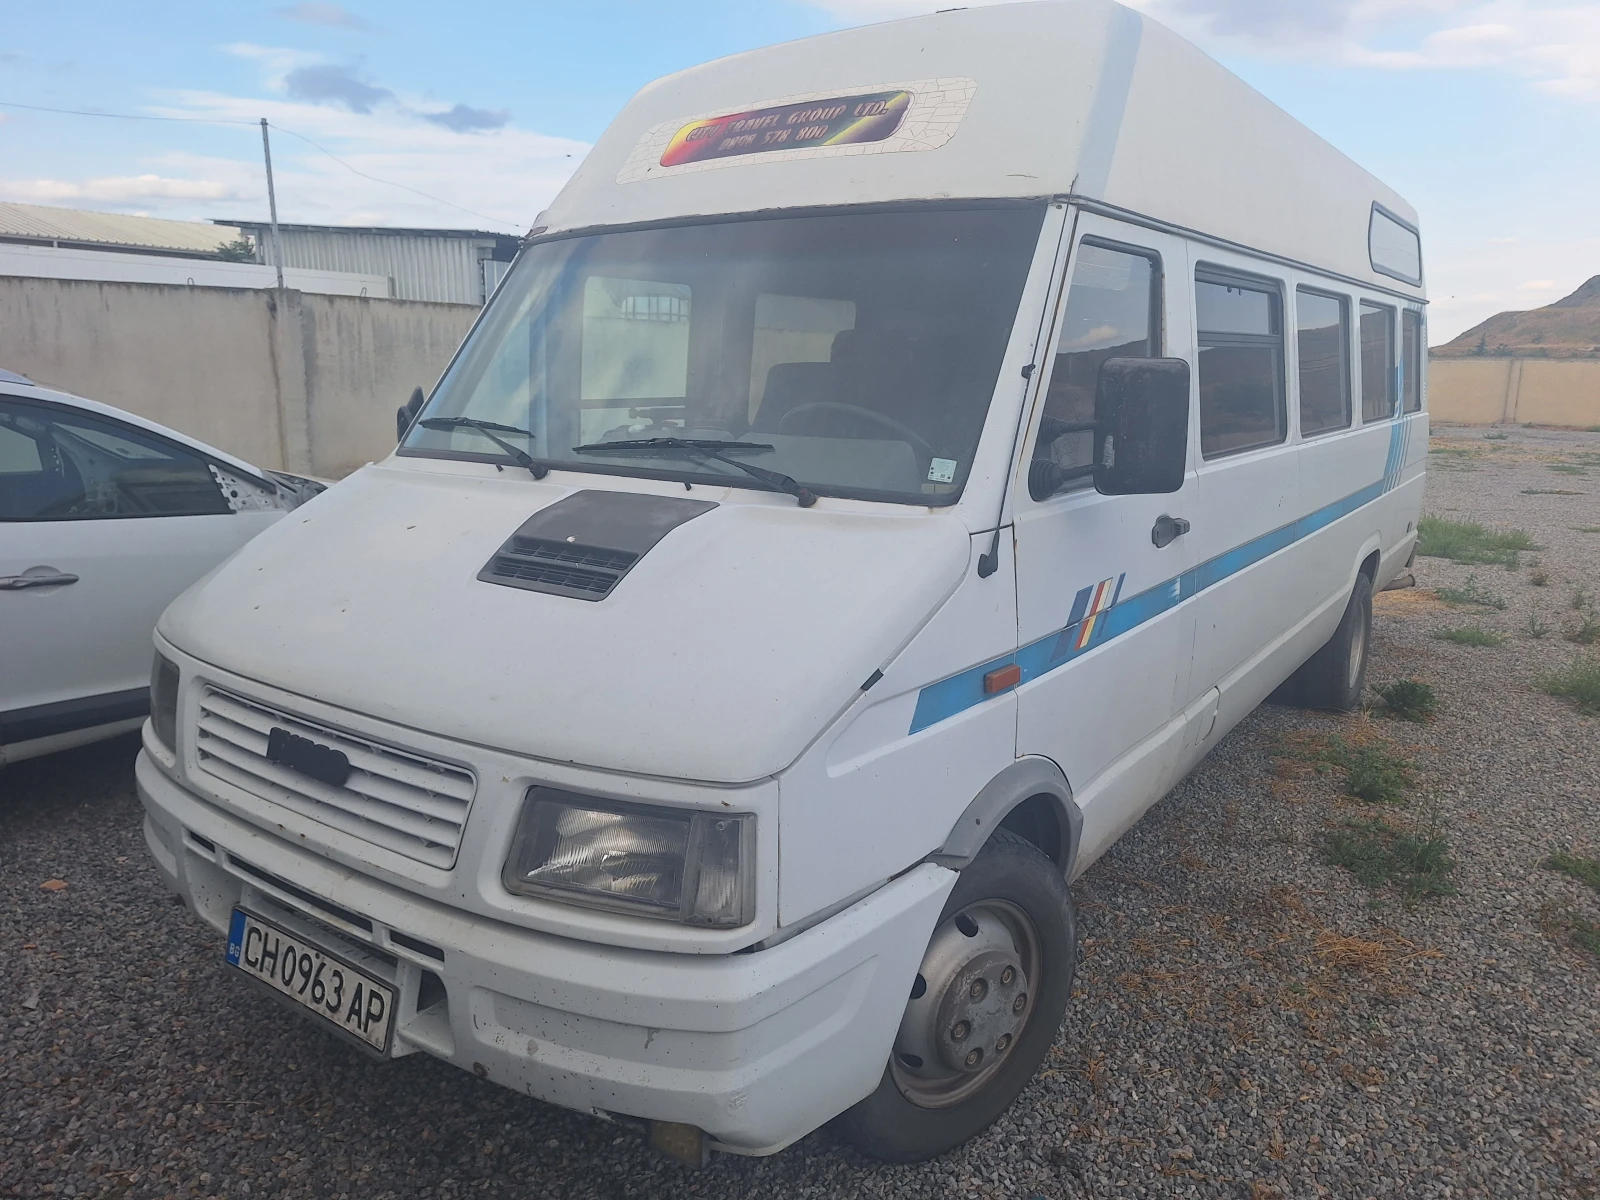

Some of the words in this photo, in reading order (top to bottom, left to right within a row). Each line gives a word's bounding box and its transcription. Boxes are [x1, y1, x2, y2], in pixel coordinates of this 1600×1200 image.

[724, 115, 780, 133] TRAVEL
[787, 105, 847, 124] GROUP
[761, 128, 792, 145] 578
[795, 124, 829, 141] 800
[229, 942, 240, 958] BG
